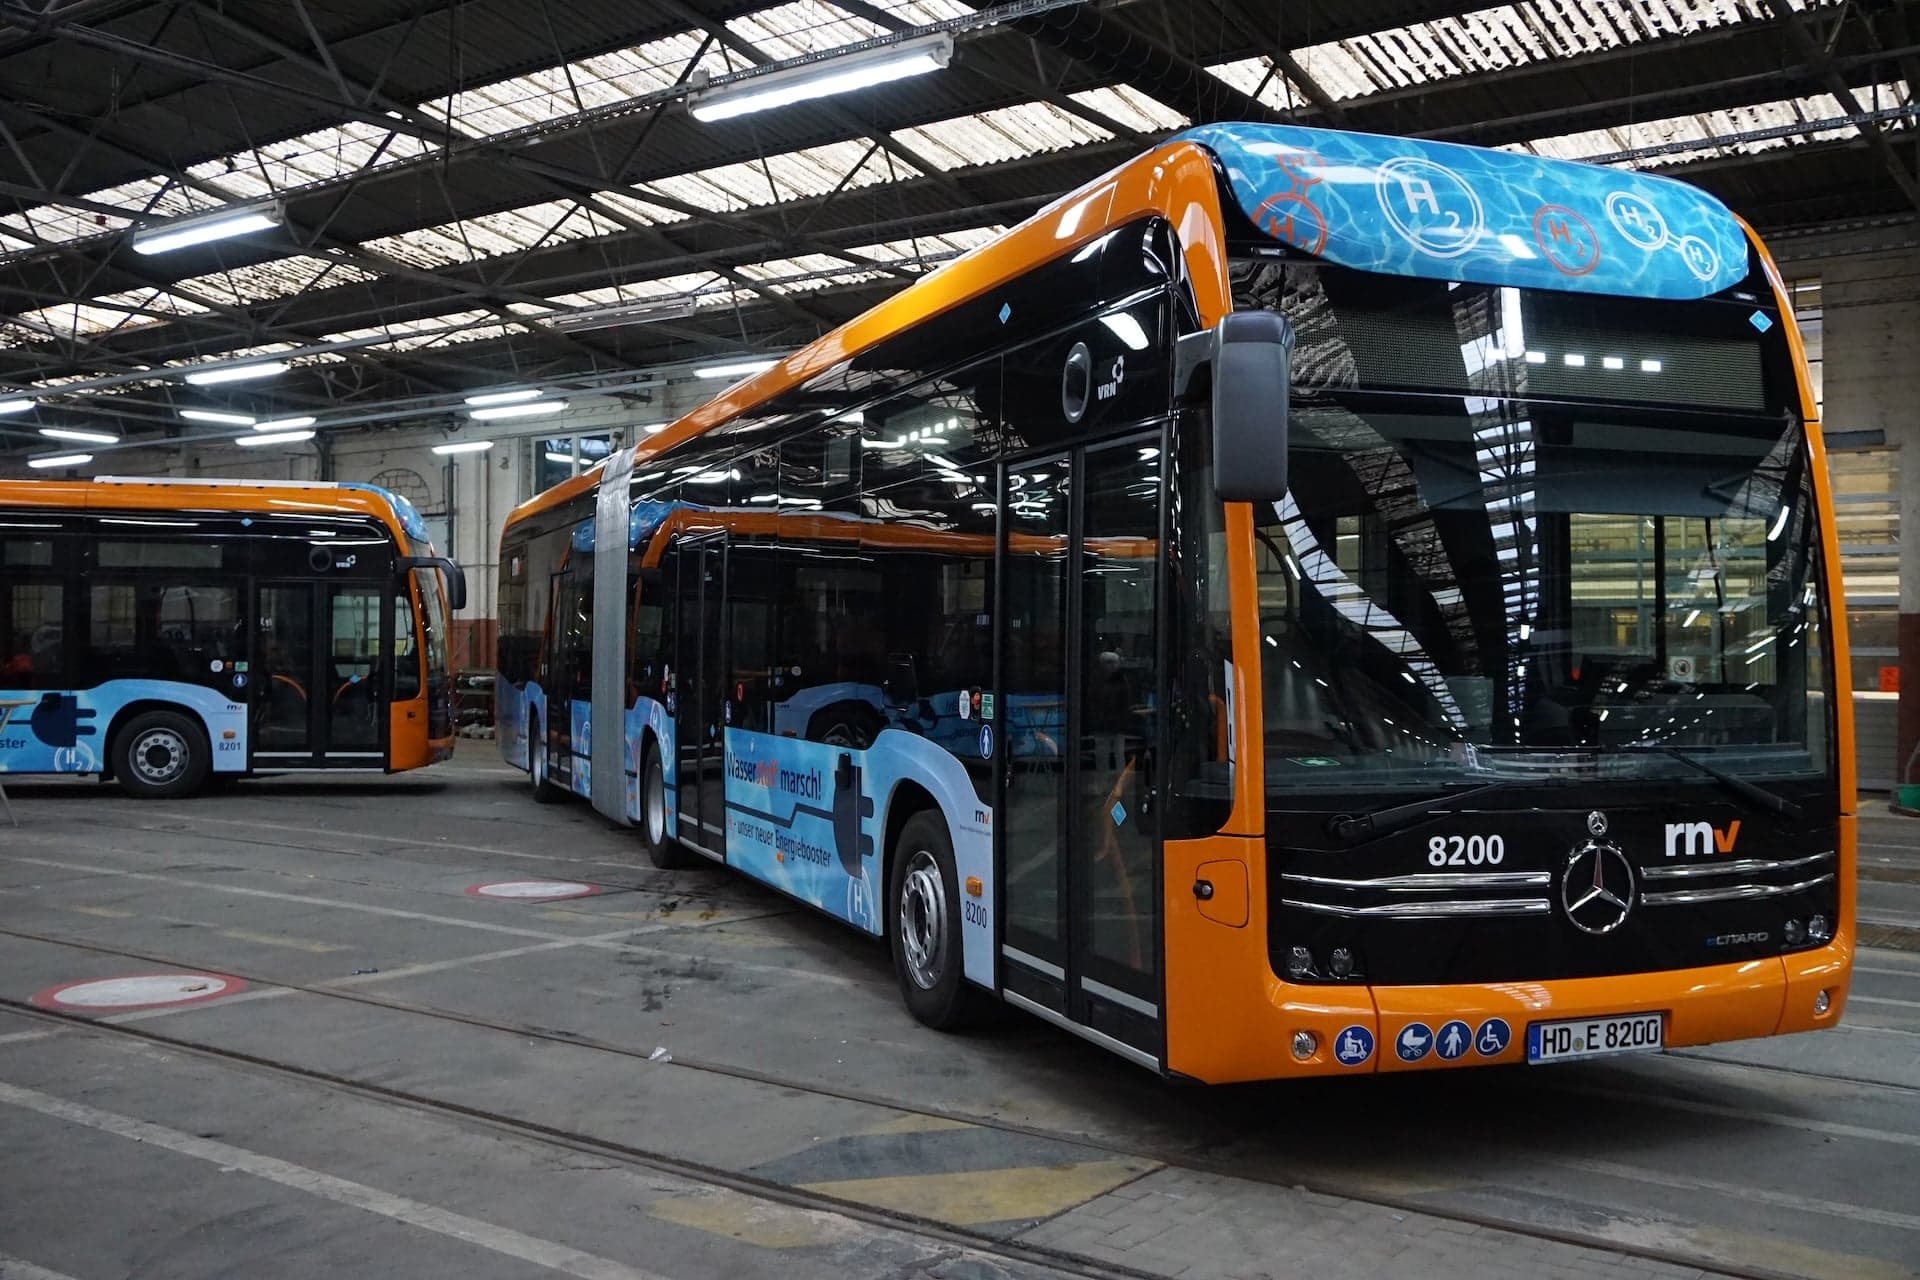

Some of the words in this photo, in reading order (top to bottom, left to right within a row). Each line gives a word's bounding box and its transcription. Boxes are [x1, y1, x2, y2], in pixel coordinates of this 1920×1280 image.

[1399, 177, 1461, 233] H2
[1549, 220, 1585, 257] H2
[1619, 204, 1659, 241] H2
[1689, 246, 1712, 273] H2
[1097, 381, 1117, 400] VRN
[219, 742, 241, 751] 8201
[781, 768, 822, 801] marsch!
[975, 810, 989, 825] rnv
[738, 821, 753, 840] unser
[755, 826, 774, 846] neuer
[775, 829, 832, 868] Energiebooster
[1428, 835, 1504, 866] 8200
[1665, 820, 1741, 857] rnv
[965, 900, 988, 929] 8200
[1542, 1027, 1571, 1055] HD
[1586, 1024, 1600, 1050] E
[1605, 1019, 1659, 1048] 8200
